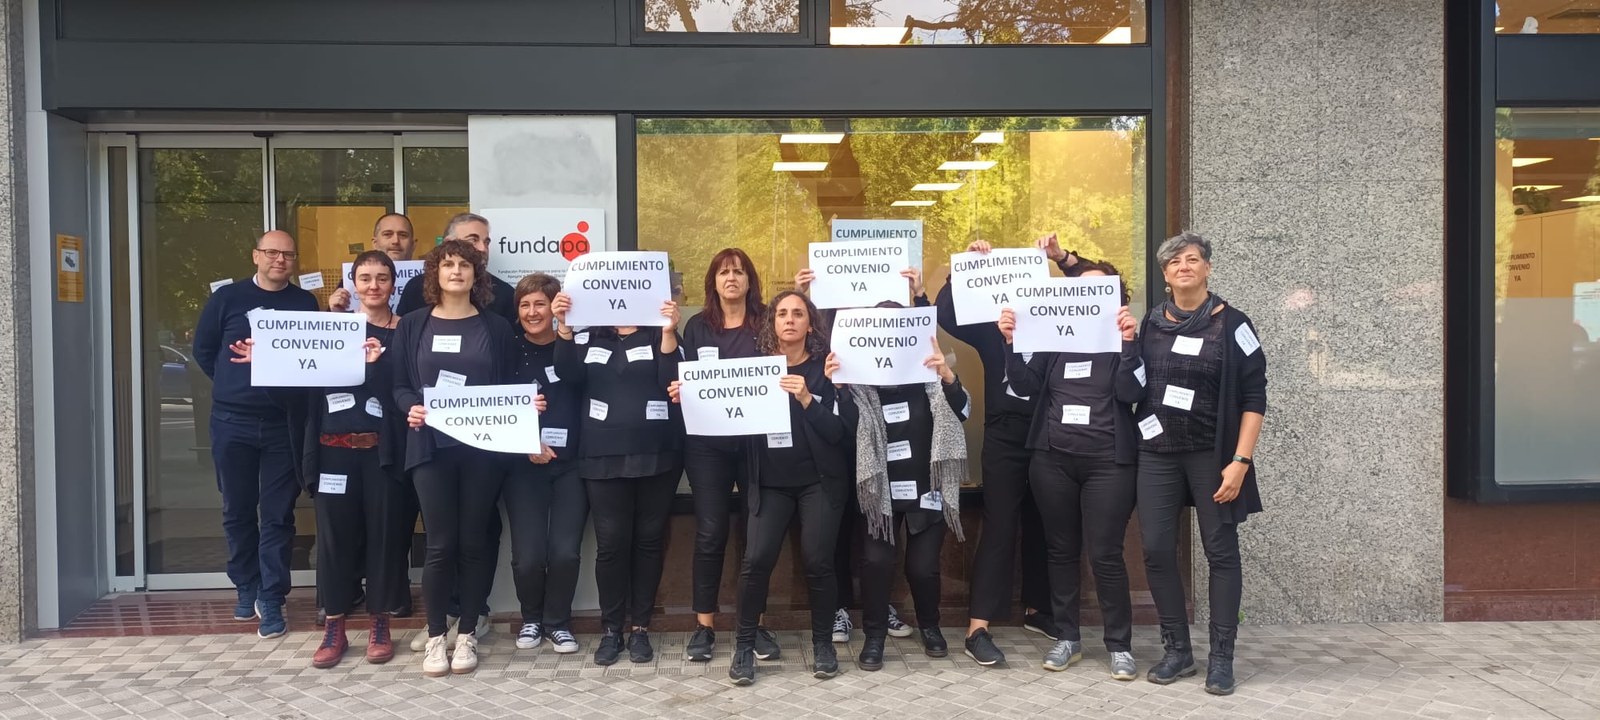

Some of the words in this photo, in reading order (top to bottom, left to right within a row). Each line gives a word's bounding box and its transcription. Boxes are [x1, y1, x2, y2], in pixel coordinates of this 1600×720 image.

[836, 229, 917, 239] CUMPLIMIENTO
[499, 236, 588, 257] fundapa
[814, 247, 902, 258] CUMPLIMIENTO
[572, 260, 664, 271] CUMPLIMIENTO
[827, 263, 890, 274] CONVENIO
[954, 255, 1043, 272] CUMPLIMIENTO
[582, 279, 652, 290] CONVENIO
[851, 282, 867, 292] YA
[1016, 285, 1114, 298] CUMPLIMIENTO
[992, 293, 1009, 304] YA
[608, 299, 627, 310] YA
[1030, 305, 1101, 316] CONVENIO
[257, 320, 360, 331] CUMPLIMIENTO
[838, 316, 931, 328] CUMPLIMIENTO
[1056, 325, 1075, 336] YA
[271, 338, 345, 350] CONVENIO
[849, 336, 918, 348] CONVENIO
[298, 358, 317, 370] YA
[875, 357, 893, 369] YA
[683, 365, 781, 381] CUMPLIMIENTO
[698, 385, 768, 400] CONVENIO
[430, 395, 531, 410] CUMPLIMIENTO
[725, 407, 744, 418] YA
[445, 414, 518, 426] CONVENIO
[473, 433, 492, 442] YA
